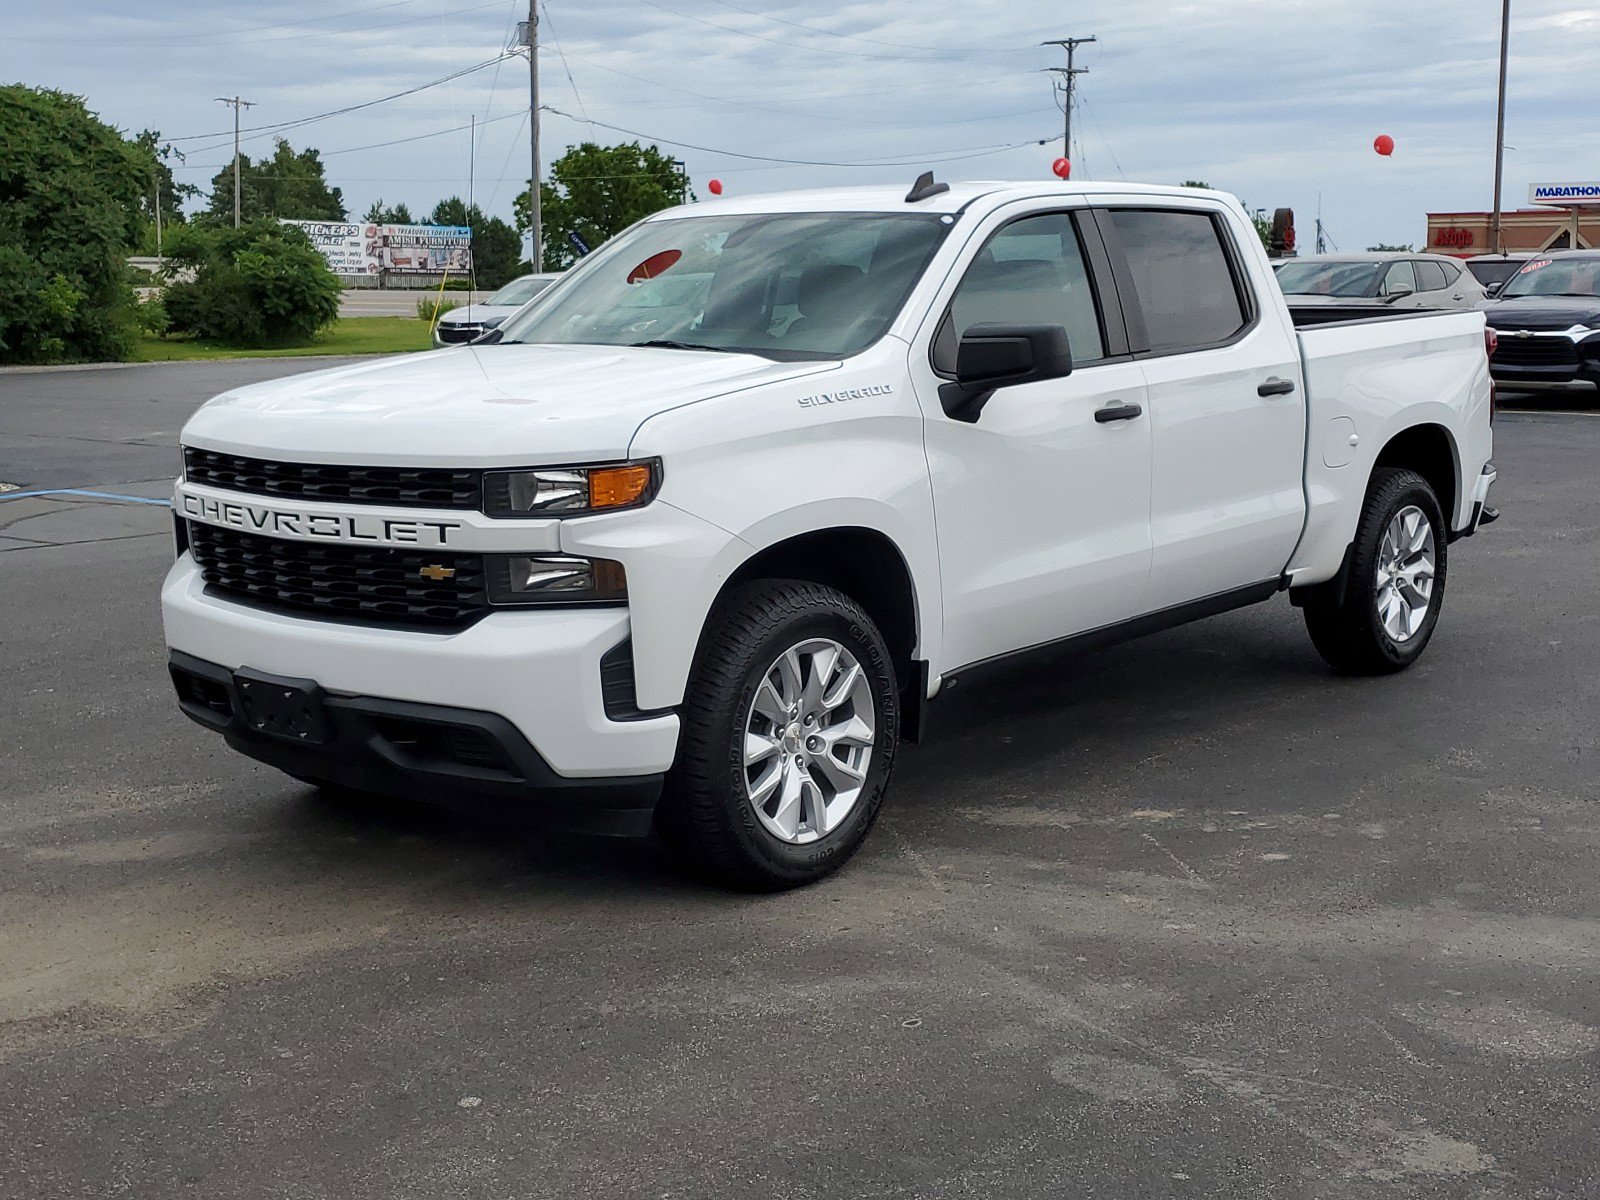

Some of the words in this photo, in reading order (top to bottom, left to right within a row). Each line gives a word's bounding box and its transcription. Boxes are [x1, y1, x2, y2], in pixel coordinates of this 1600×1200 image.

[1536, 187, 1600, 197] MARATHON
[397, 227, 430, 236] TREASURES
[1434, 228, 1473, 249] Arby's
[388, 235, 416, 245] AMISH
[797, 384, 893, 408] SILVERADO
[183, 493, 461, 546] CHEVROLET
